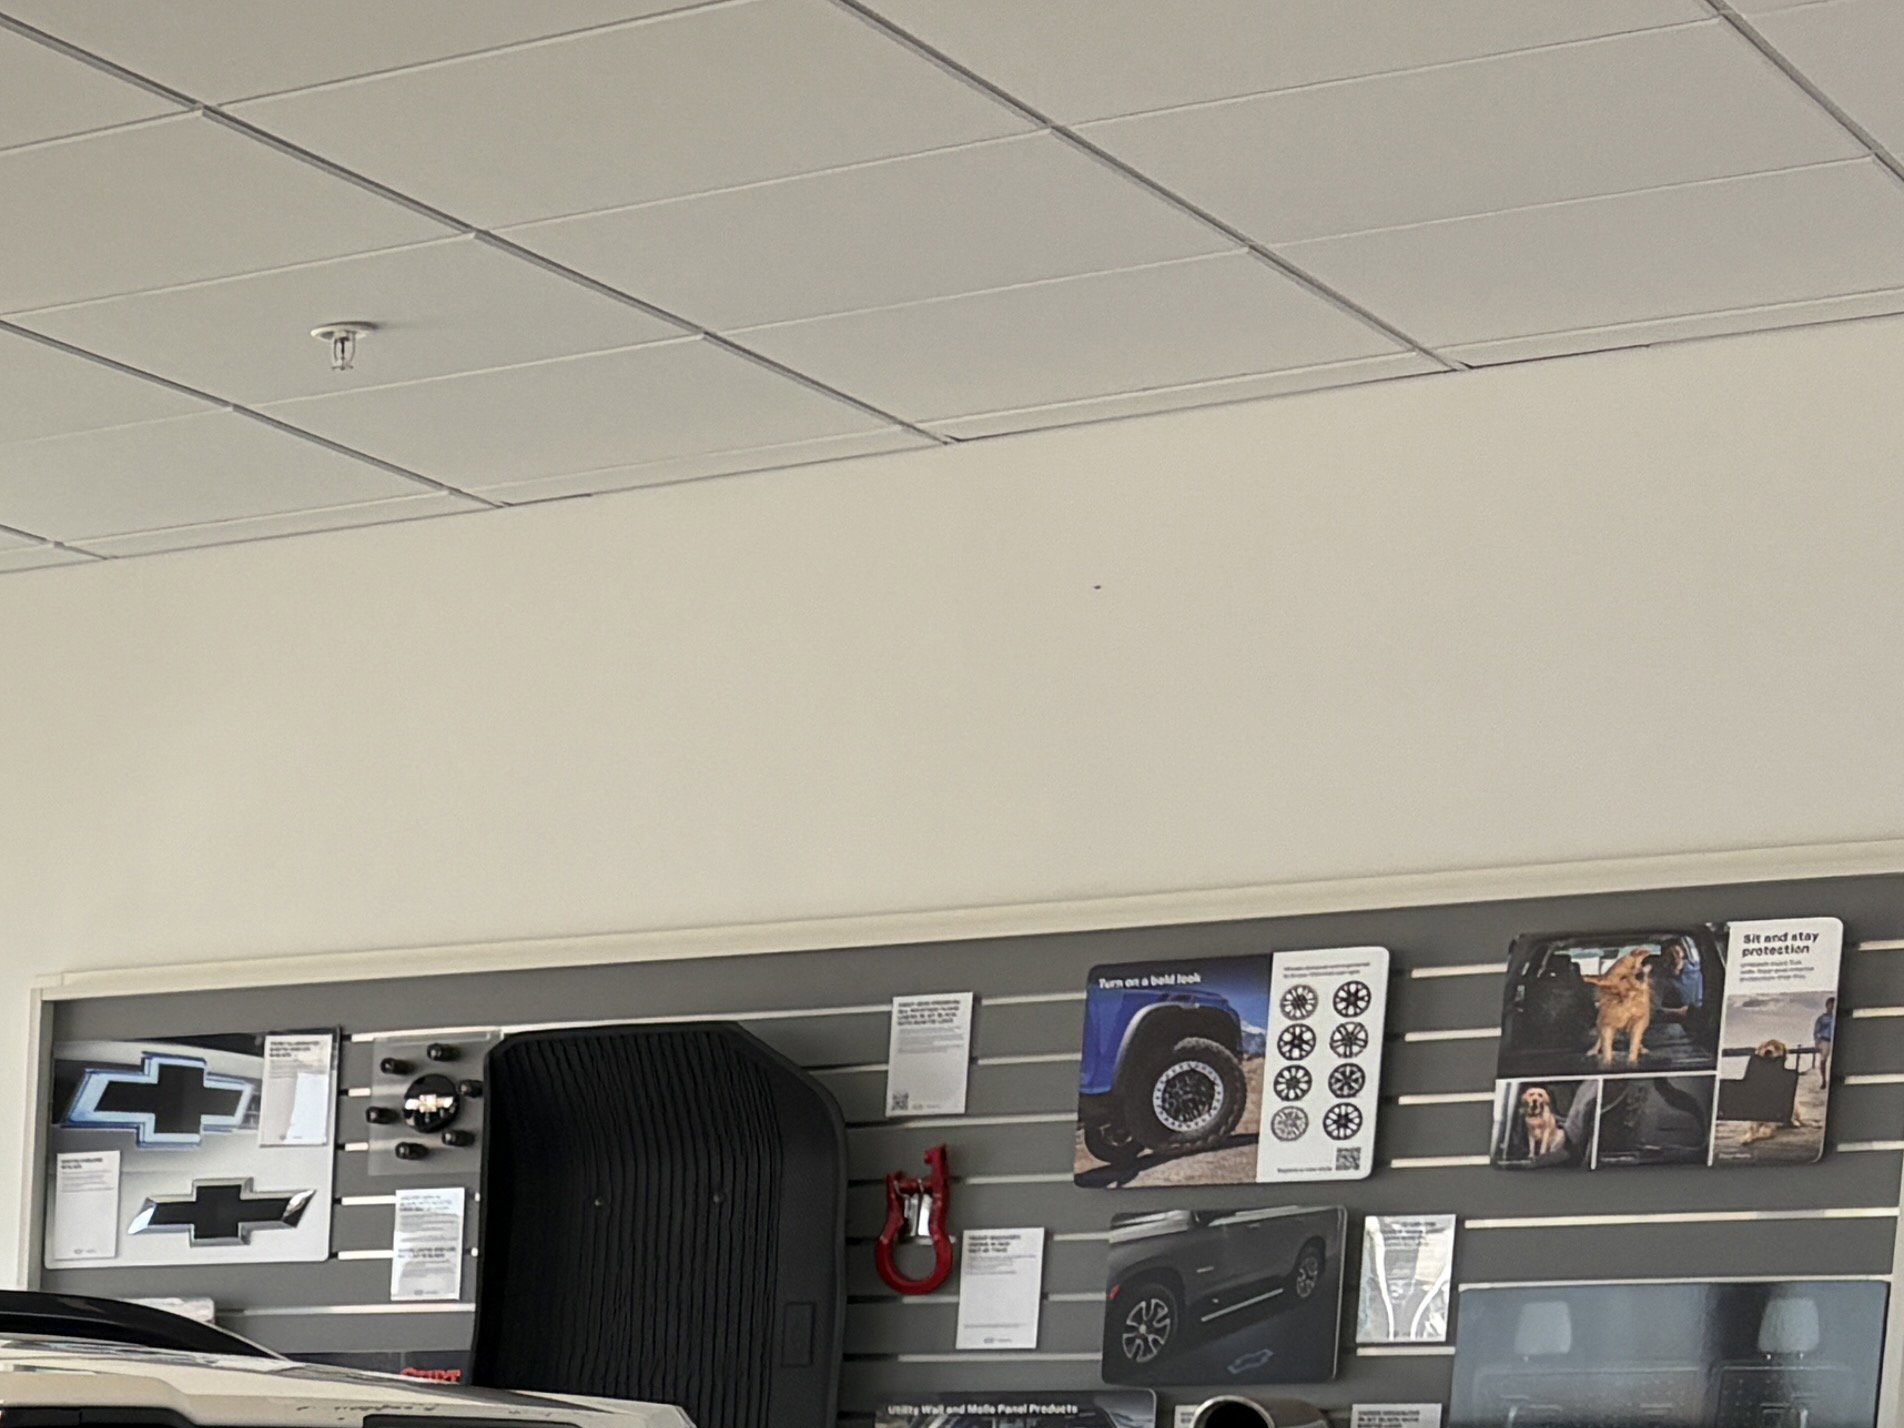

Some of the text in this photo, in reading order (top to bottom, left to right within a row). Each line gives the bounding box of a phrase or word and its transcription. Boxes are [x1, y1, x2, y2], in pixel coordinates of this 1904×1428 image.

[1743, 931, 1819, 944] Sit and stay
[1742, 944, 1810, 958] protection
[1099, 978, 1123, 989] Turn
[1124, 978, 1139, 988] on
[1150, 975, 1175, 986] bold
[1176, 972, 1201, 984] look
[888, 1405, 919, 1416] Utility
[997, 1404, 1027, 1414] Panel
[1029, 1404, 1078, 1414] Products
